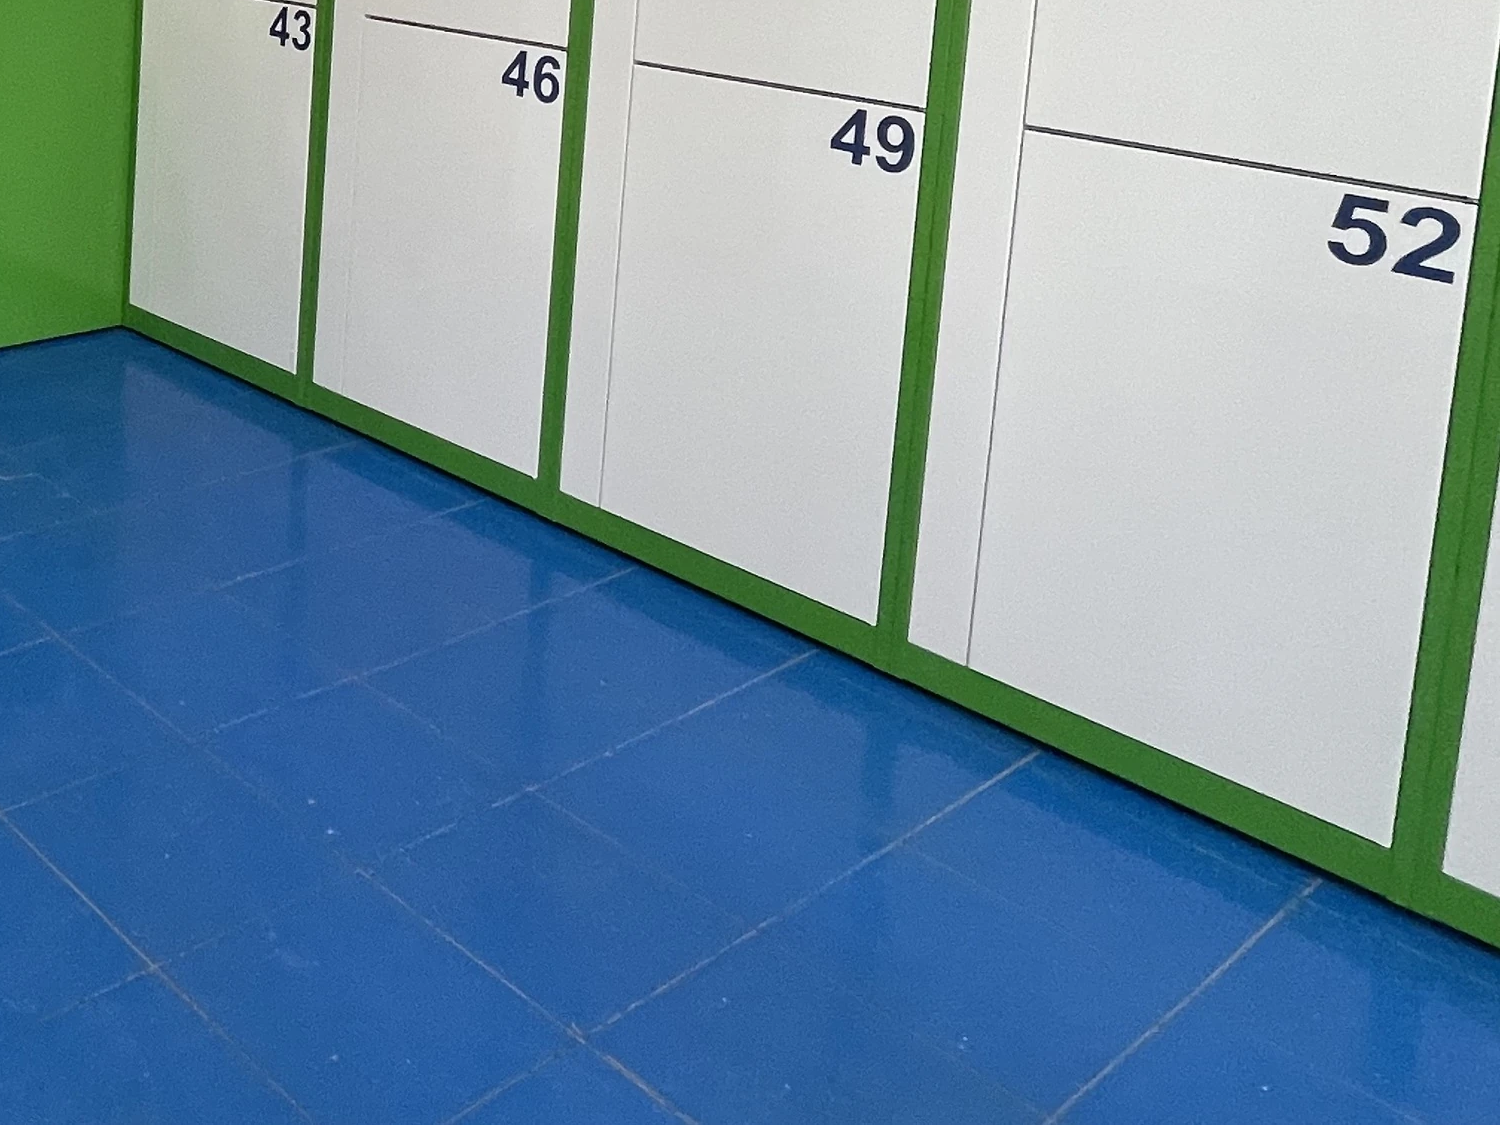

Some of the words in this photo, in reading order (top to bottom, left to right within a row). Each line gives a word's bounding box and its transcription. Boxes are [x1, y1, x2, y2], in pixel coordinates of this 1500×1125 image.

[269, 6, 312, 51] 43
[502, 50, 560, 103] 46
[830, 109, 916, 173] 49
[1326, 193, 1462, 284] 52
